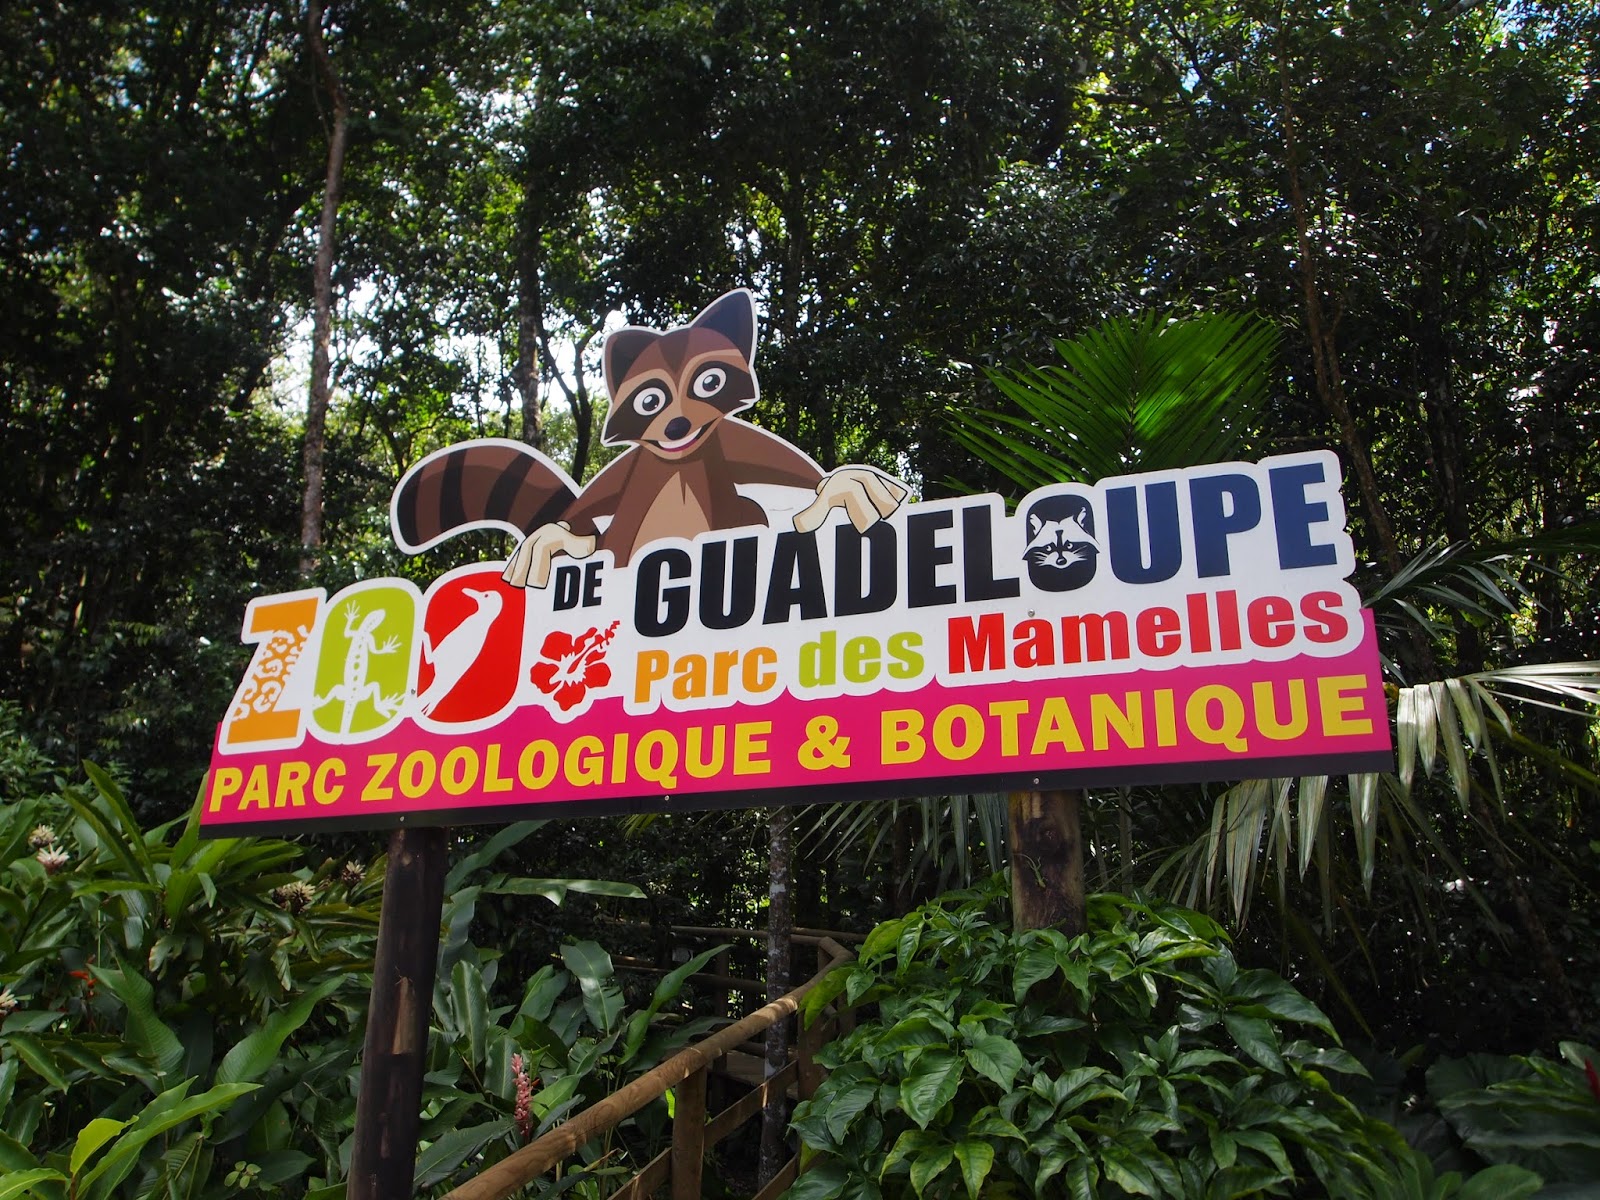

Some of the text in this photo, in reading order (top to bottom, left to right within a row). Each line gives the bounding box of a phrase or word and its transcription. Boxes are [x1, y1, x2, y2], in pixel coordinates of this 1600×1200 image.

[227, 462, 1338, 744] ZOO DE GUADELOUPE
[634, 590, 1349, 704] Parc des Mamelles
[208, 674, 1374, 812] PARC ZOOLOGIQUE & BOTANIQUE
